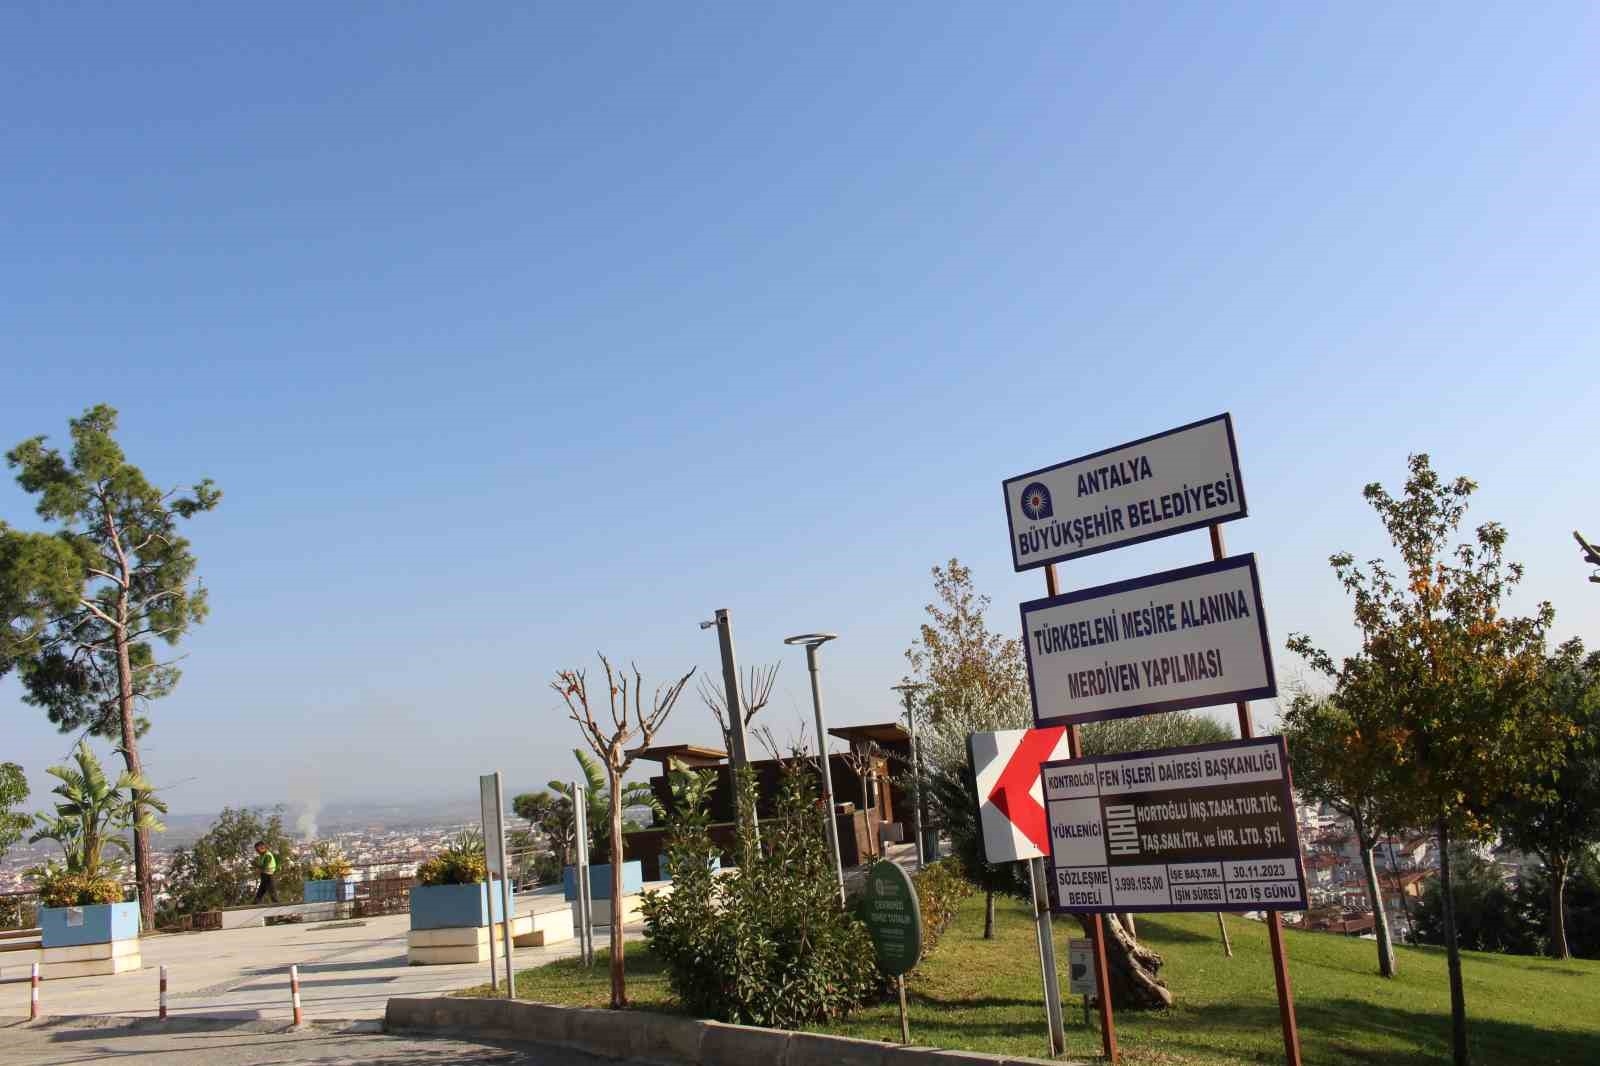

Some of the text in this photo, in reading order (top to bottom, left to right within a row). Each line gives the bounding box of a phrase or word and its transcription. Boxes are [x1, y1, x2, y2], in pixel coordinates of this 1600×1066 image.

[1077, 456, 1152, 497] ANTALYA
[1019, 473, 1234, 556] BÜYÜKŞEHİR BELEDİYESİ
[1034, 590, 1249, 655] TÜRKBELENİ MESİRE ALANINA
[1068, 649, 1223, 699] MERDİVEN YAPILMASI
[1100, 750, 1277, 789] FEN İŞLERİ DAİRESİ BAŞKANLIĞI
[1136, 800, 1188, 822] HORTOĞLU
[1052, 820, 1102, 839] YÜKLENİCİ
[1204, 834, 1216, 847] ve
[1216, 825, 1238, 846] İHR.
[1240, 827, 1262, 845] LTD.
[1264, 821, 1285, 848] ŞTİ.
[1059, 869, 1109, 888] SÖZLEŞME
[1233, 864, 1286, 878] 30.11.2023
[1069, 888, 1102, 904] BEDELİ
[1192, 886, 1222, 900] SÜRESİ
[1229, 883, 1296, 902] 120 İŞ GÜNÜ
